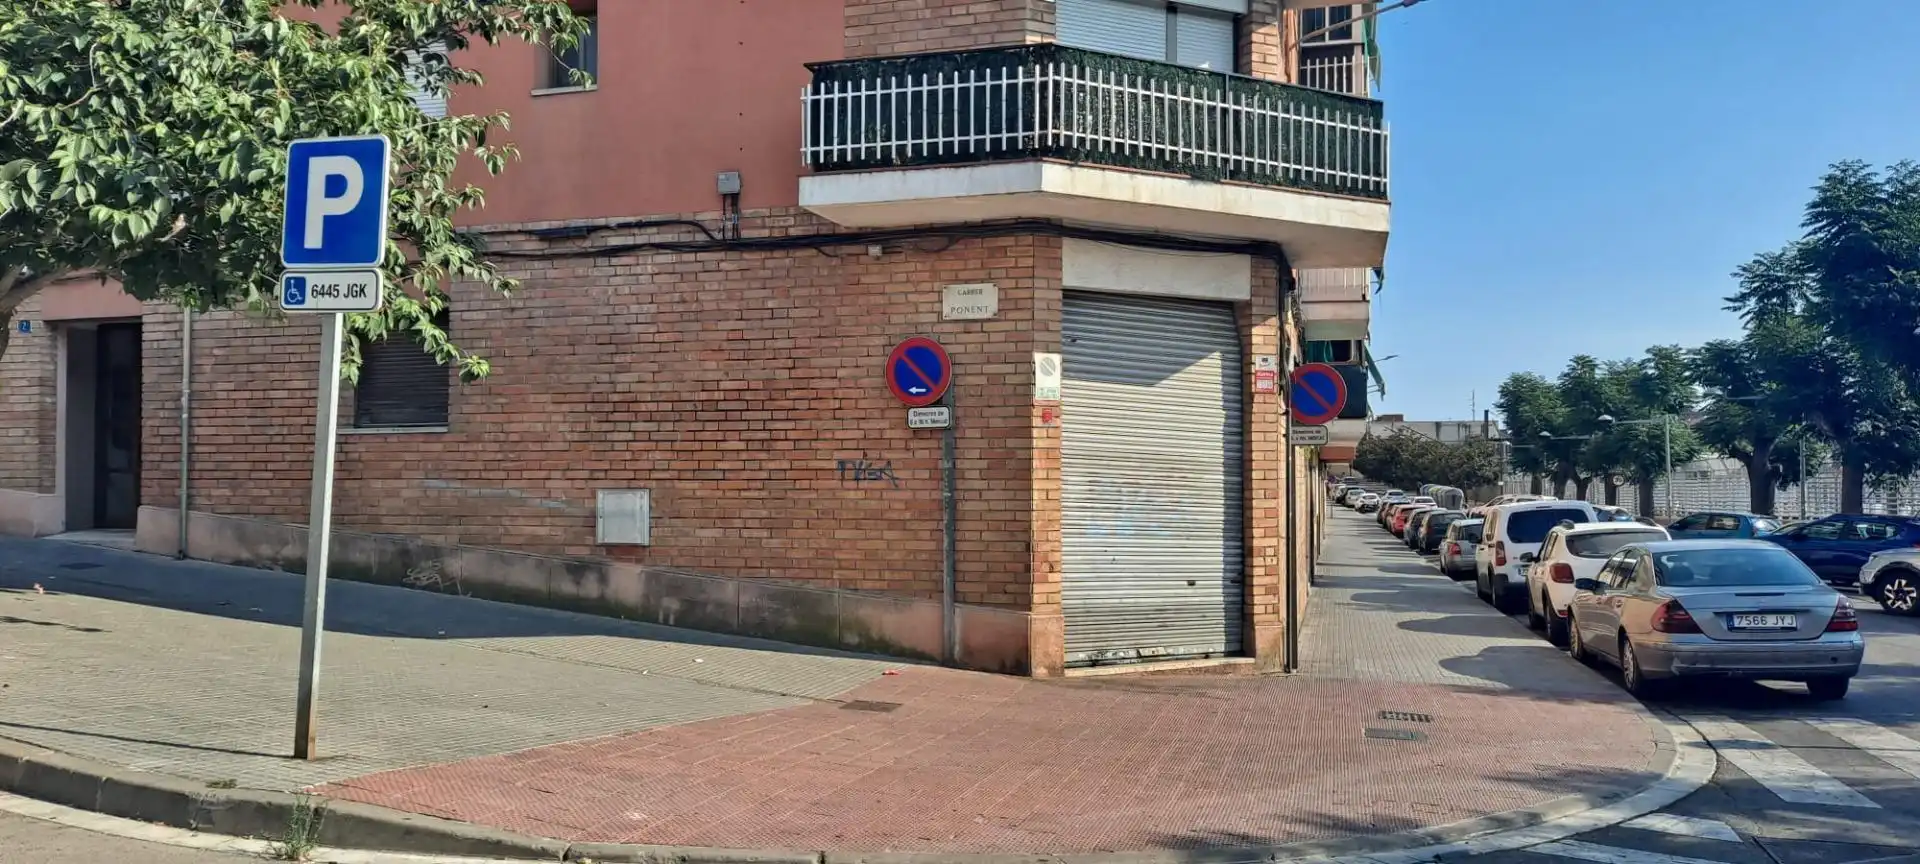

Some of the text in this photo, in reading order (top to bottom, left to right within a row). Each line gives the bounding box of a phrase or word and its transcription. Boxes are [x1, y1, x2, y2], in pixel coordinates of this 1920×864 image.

[304, 155, 364, 249] P
[311, 283, 367, 299] 6445 JGK
[951, 305, 988, 315] PONENT
[1736, 615, 1794, 626] 7566 JYJ
